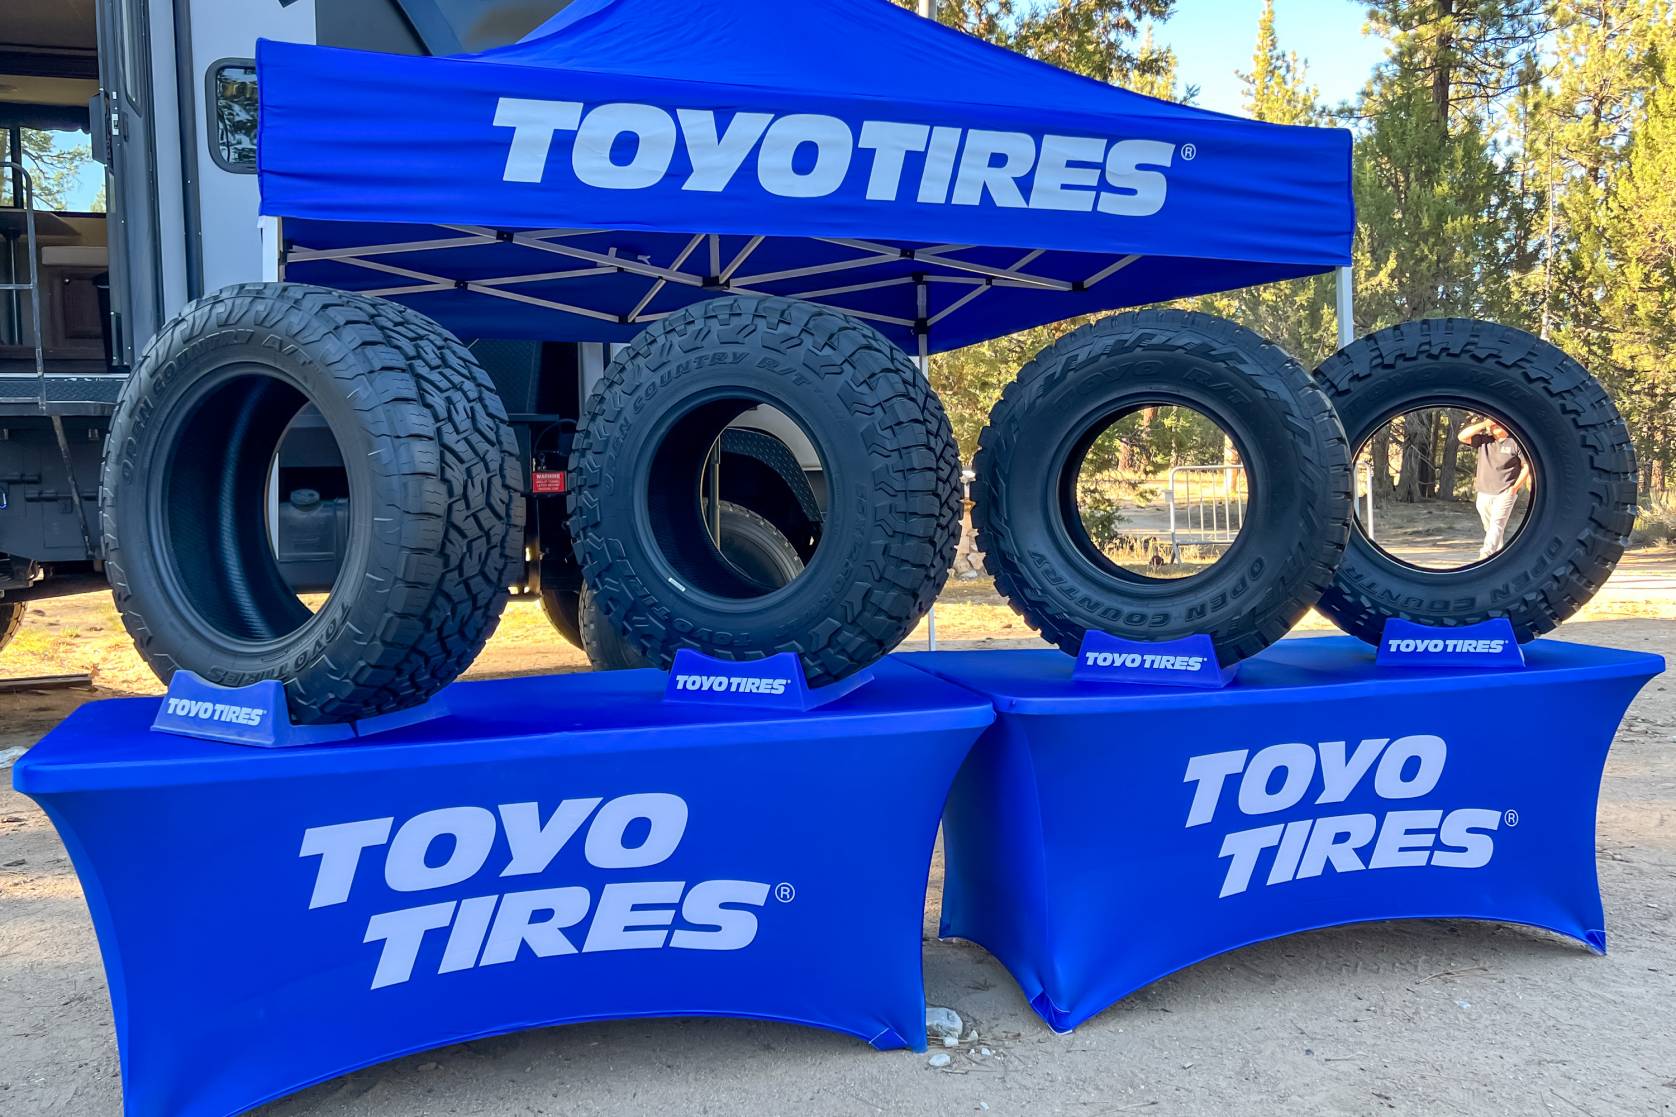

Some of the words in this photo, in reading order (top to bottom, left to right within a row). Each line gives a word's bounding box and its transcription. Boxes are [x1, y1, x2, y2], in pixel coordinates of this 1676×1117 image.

[632, 351, 750, 415] COUNTRY
[1028, 549, 1172, 628] COUNTRY
[1184, 556, 1266, 622] OPEN
[1345, 565, 1473, 611] COUNTR
[1183, 734, 1448, 828] TOYO
[299, 793, 688, 909] TOYO
[1218, 808, 1502, 899] TIRES
[363, 879, 771, 990] TIRES
